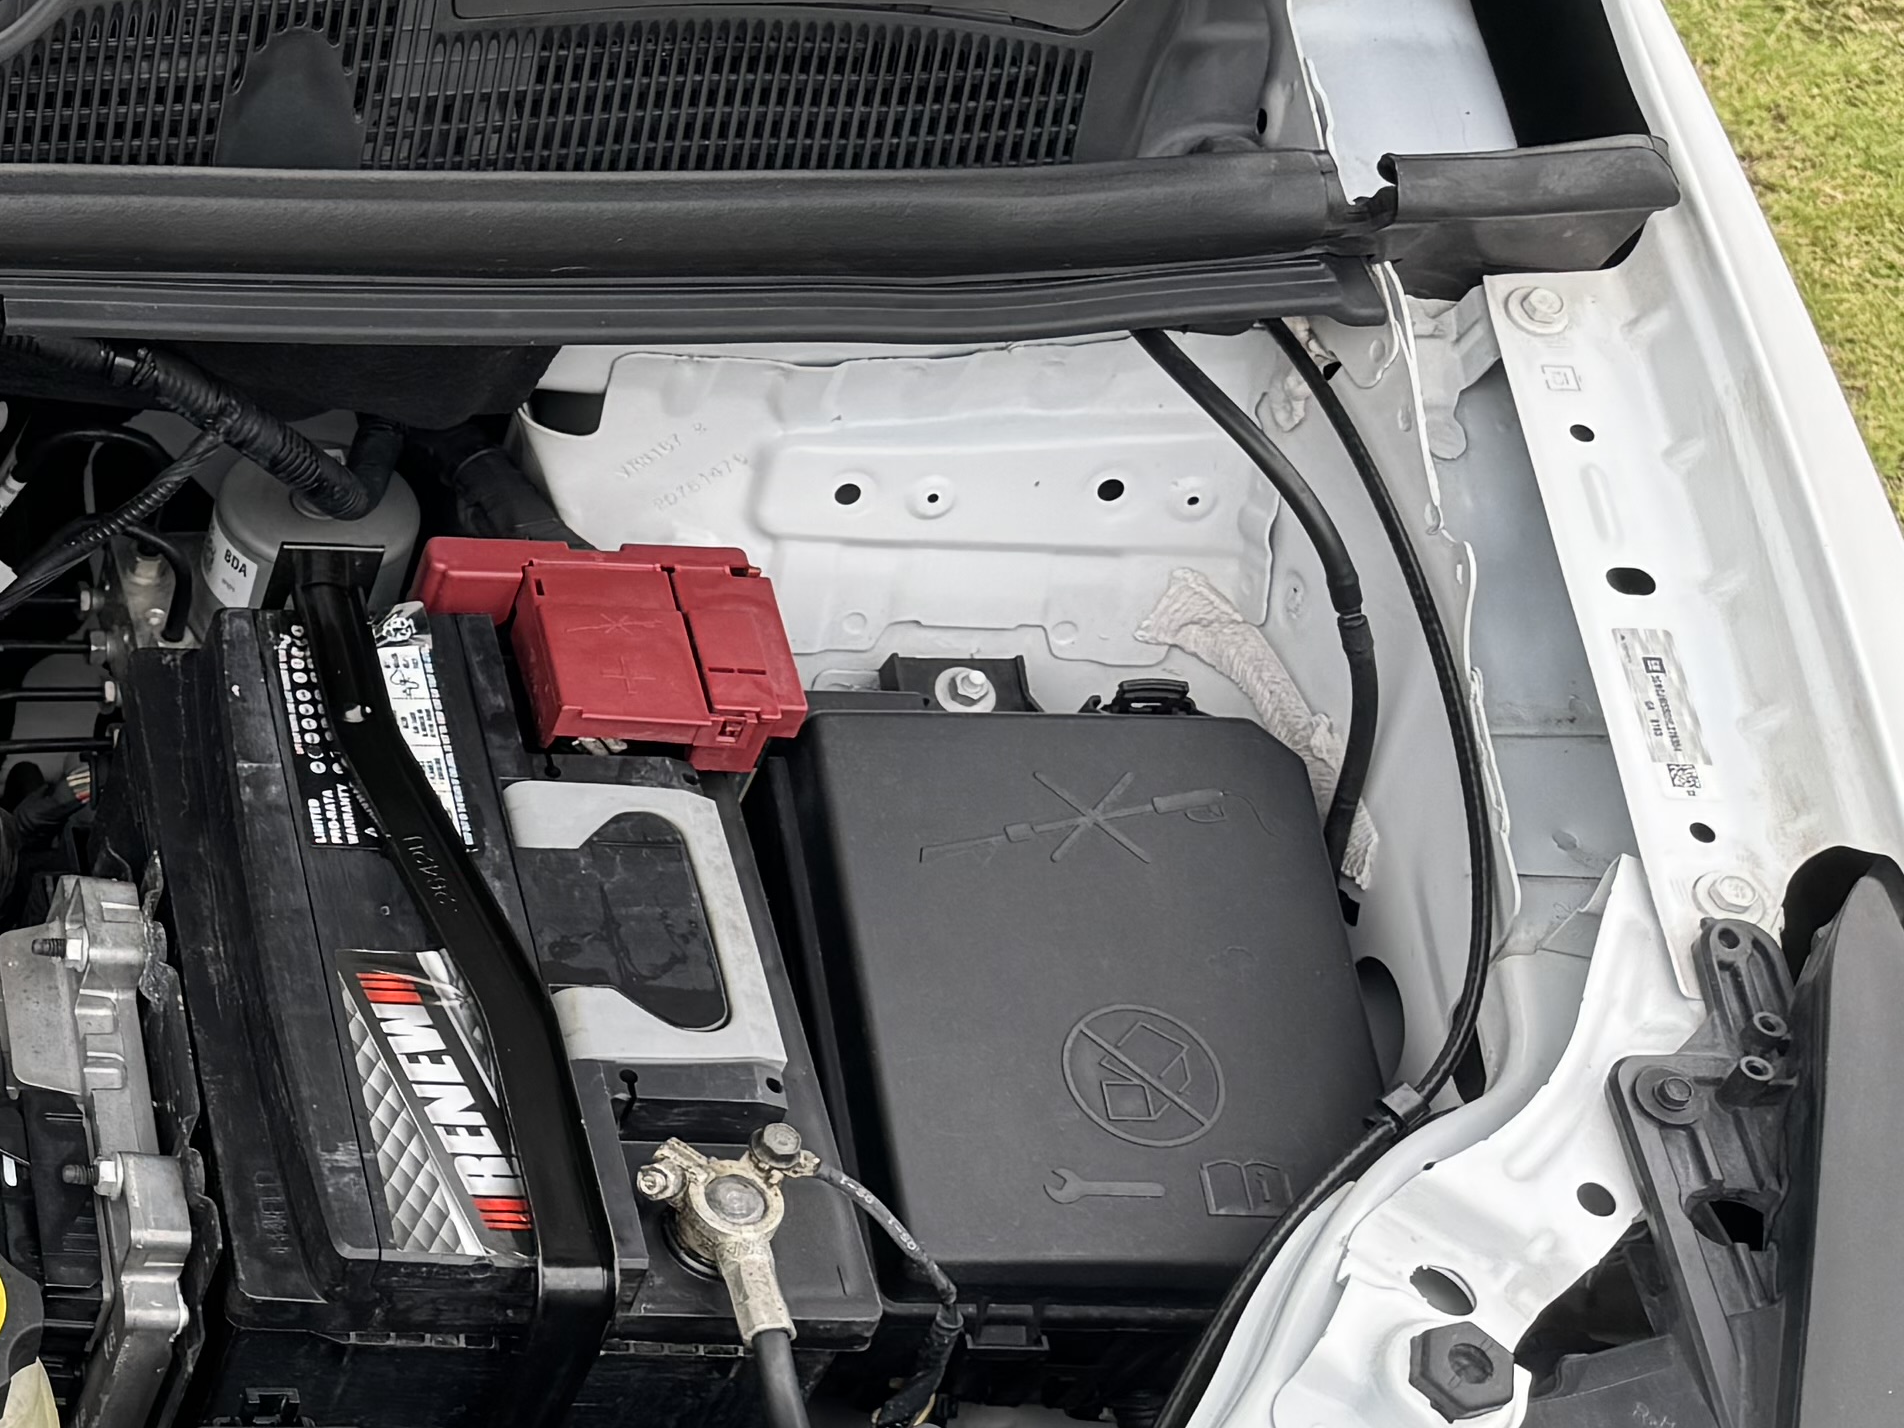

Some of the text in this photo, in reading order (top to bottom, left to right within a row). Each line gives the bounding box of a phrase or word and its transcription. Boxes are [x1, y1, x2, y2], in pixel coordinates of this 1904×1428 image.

[307, 798, 328, 844] LIMITED
[322, 789, 343, 844] PRO-RATA
[336, 783, 360, 844] WARRANTY
[370, 1003, 525, 1197] RENEW
